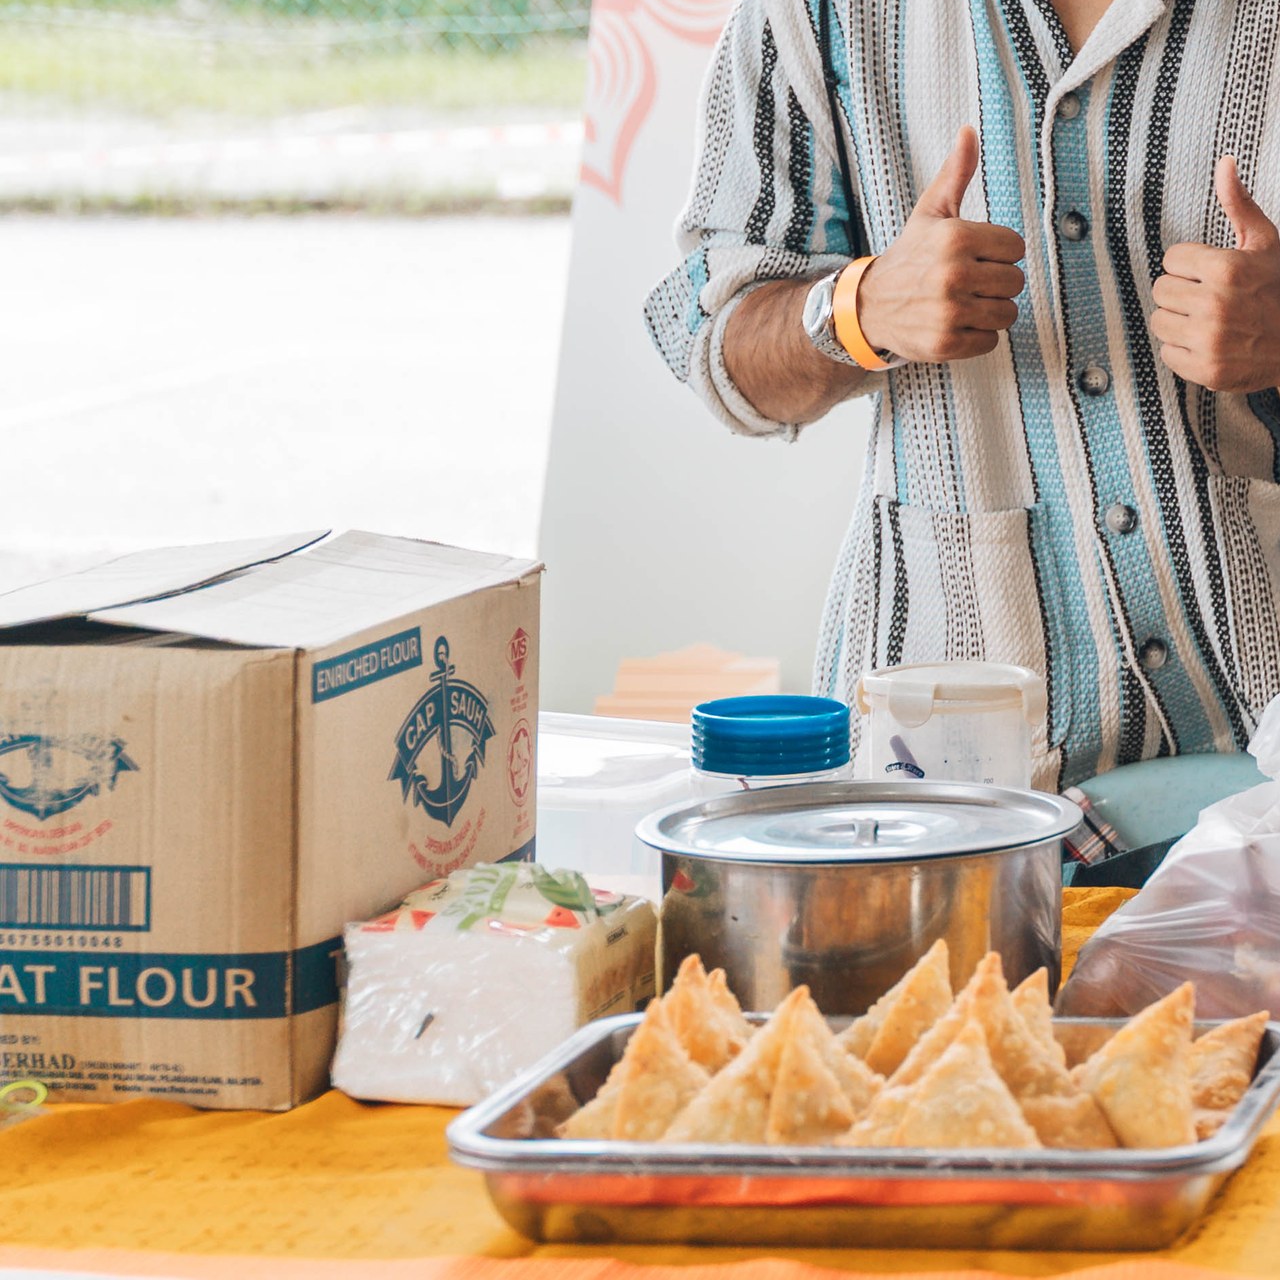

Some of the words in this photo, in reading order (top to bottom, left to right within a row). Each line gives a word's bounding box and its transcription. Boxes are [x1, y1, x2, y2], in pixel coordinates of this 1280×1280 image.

[316, 652, 379, 694] ENRICHED
[380, 636, 419, 666] FLOUR
[405, 702, 436, 751] CAP
[450, 691, 485, 730] SAUH
[79, 966, 257, 1008] FLOUR
[0, 1052, 76, 1070] ERHAD
